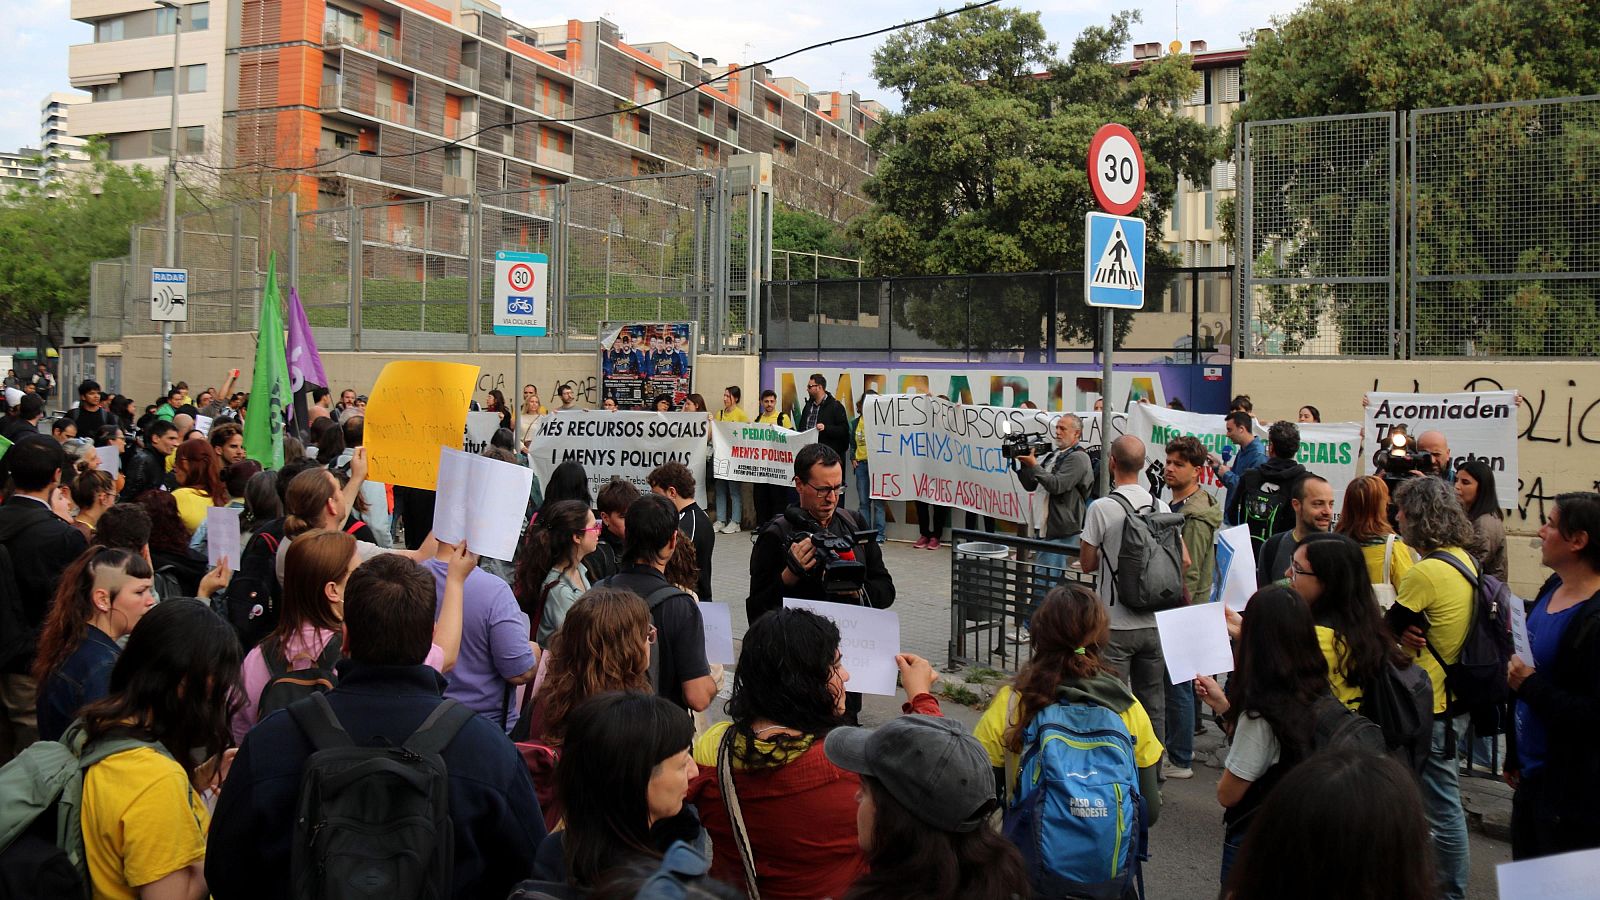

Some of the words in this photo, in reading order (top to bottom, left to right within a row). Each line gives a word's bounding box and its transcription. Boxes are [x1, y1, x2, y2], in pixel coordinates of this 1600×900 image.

[1104, 154, 1133, 184] 30
[154, 273, 185, 281] RADAR
[514, 271, 528, 285] 30
[874, 394, 928, 427] MÉS
[1374, 396, 1509, 419] Acomiaden
[567, 420, 644, 438] RECURSOS
[648, 421, 707, 438] SOCIALS
[463, 437, 487, 453] itut
[731, 445, 760, 460] MENYS
[761, 448, 793, 463] POLICIA
[877, 432, 893, 453] I
[900, 432, 954, 462] MENYS
[1299, 439, 1352, 465] CIALS
[551, 449, 557, 464] I
[562, 449, 616, 466] MENYS
[620, 451, 691, 467] POLICIALS
[871, 473, 901, 497] LES
[913, 473, 953, 503] VAGUES
[1069, 797, 1090, 807] PASO
[1069, 807, 1108, 818] NOROESTE
